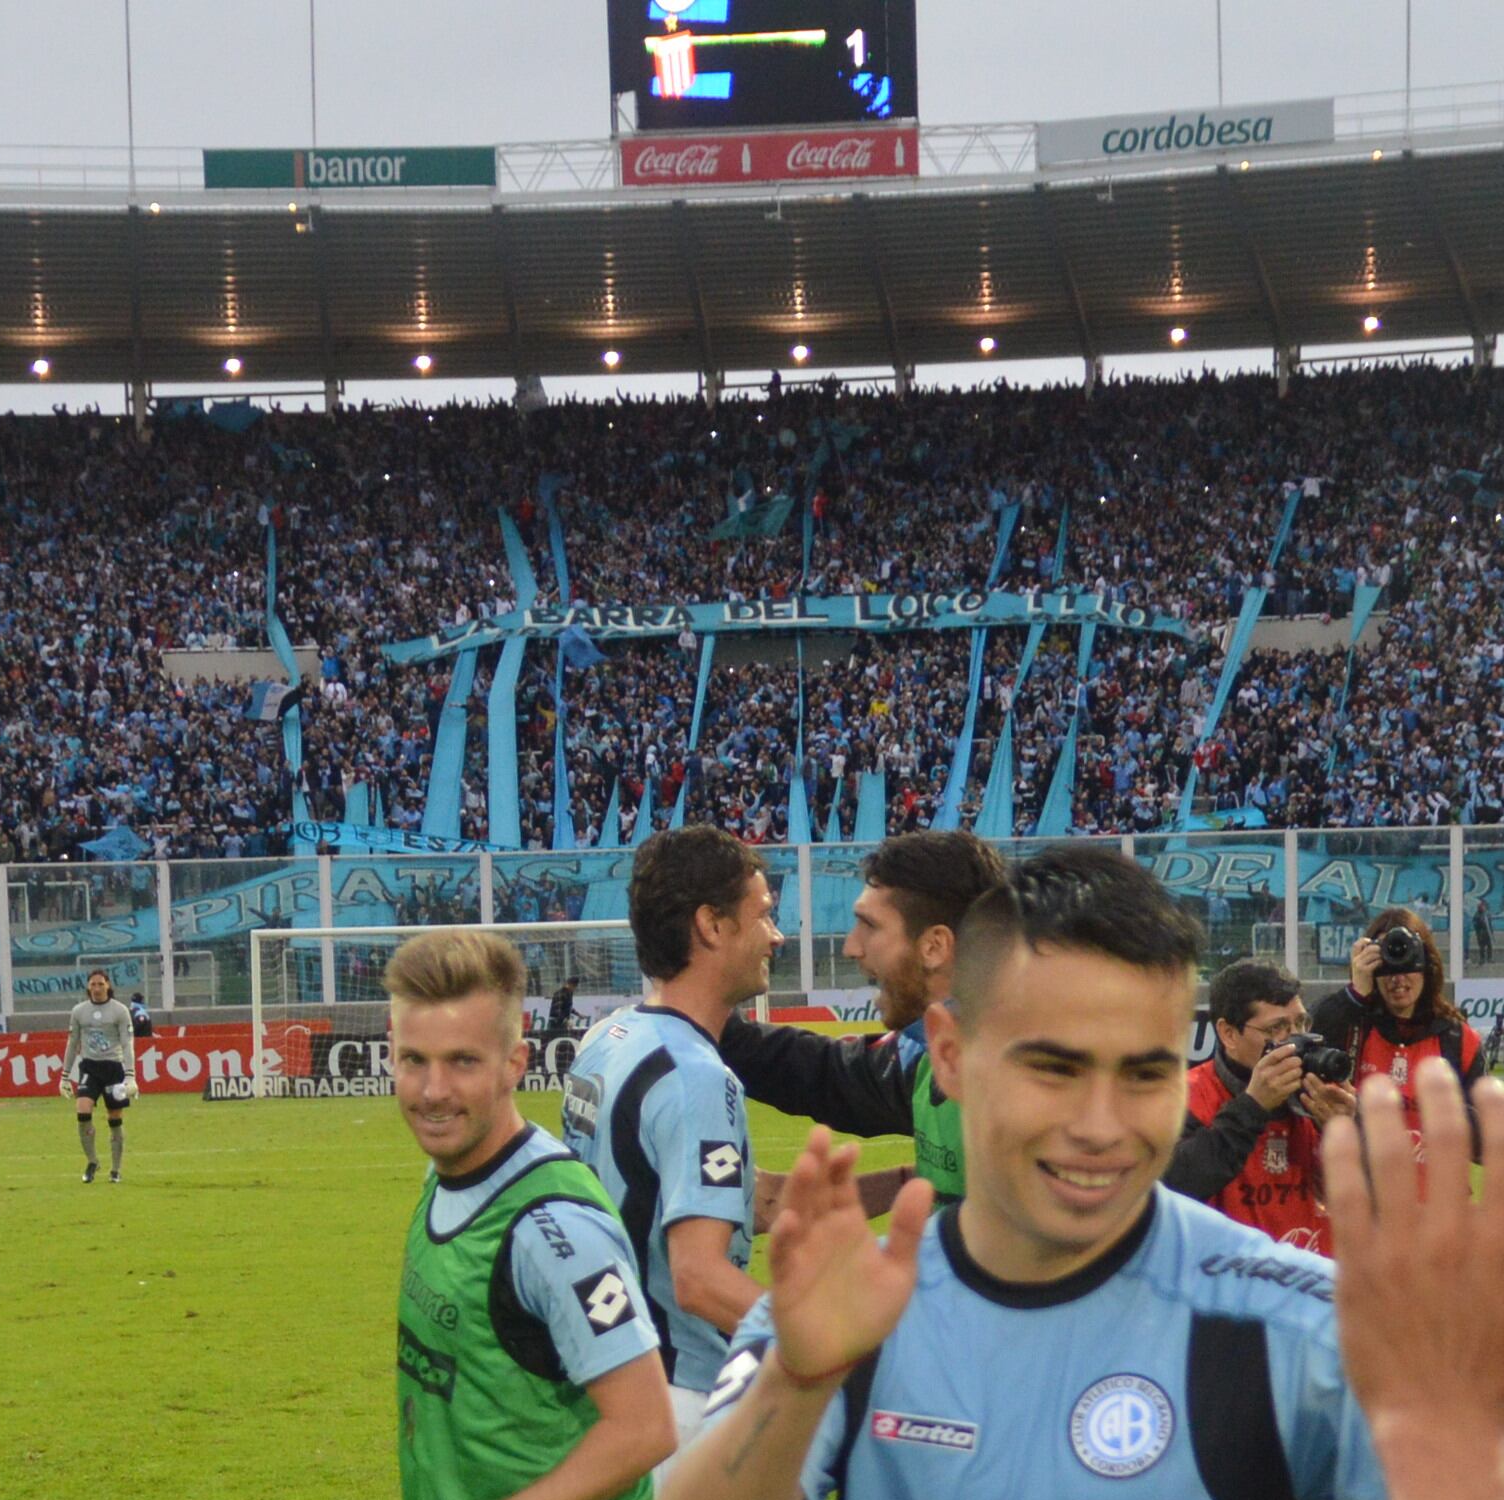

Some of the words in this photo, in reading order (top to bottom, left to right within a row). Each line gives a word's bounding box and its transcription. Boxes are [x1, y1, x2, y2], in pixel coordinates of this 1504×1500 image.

[1101, 113, 1273, 155] cordobesa
[308, 151, 406, 187] bancor
[634, 144, 722, 177] Coca-Cola
[786, 138, 876, 171] Coca-Cola
[523, 605, 694, 630] BARRA
[723, 599, 829, 624] DEL
[1150, 851, 1274, 896] DE
[897, 1420, 975, 1448] lotto
